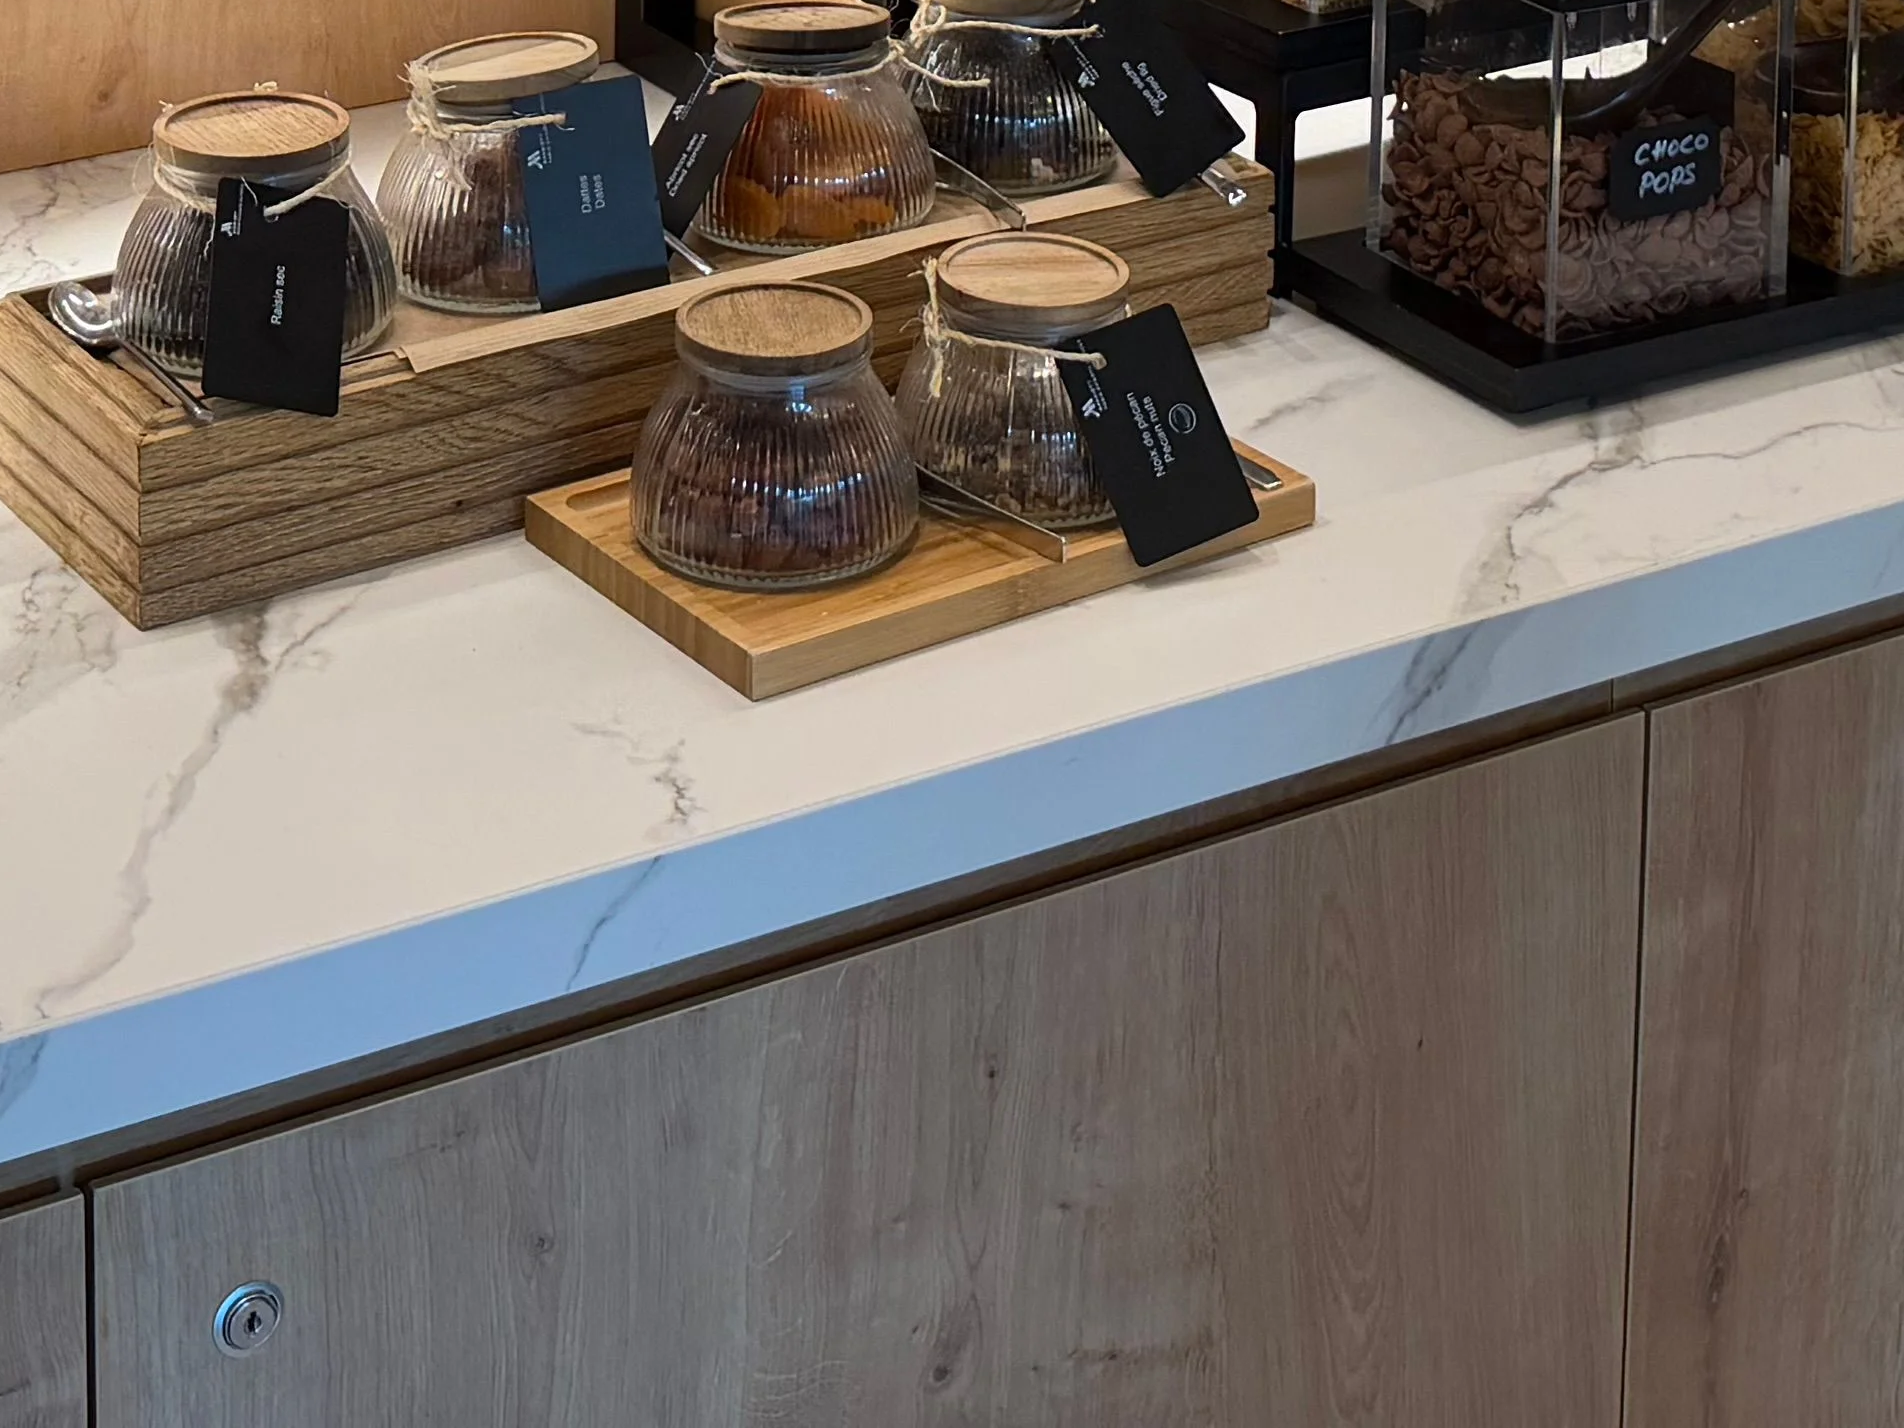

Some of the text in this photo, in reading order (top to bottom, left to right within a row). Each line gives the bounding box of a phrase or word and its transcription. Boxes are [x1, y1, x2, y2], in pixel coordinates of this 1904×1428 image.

[1142, 89, 1165, 117] Figue
[1146, 75, 1168, 101] Dried
[1634, 133, 1710, 167] CHOCO
[579, 175, 593, 214] Dattes
[593, 174, 606, 209] Dates
[668, 168, 688, 197] Dried
[1639, 162, 1696, 199] POPS
[270, 265, 286, 325] Raisin sec
[1142, 431, 1154, 447] de
[1143, 395, 1176, 463] Pecan nuts
[1149, 448, 1167, 478] Noix
